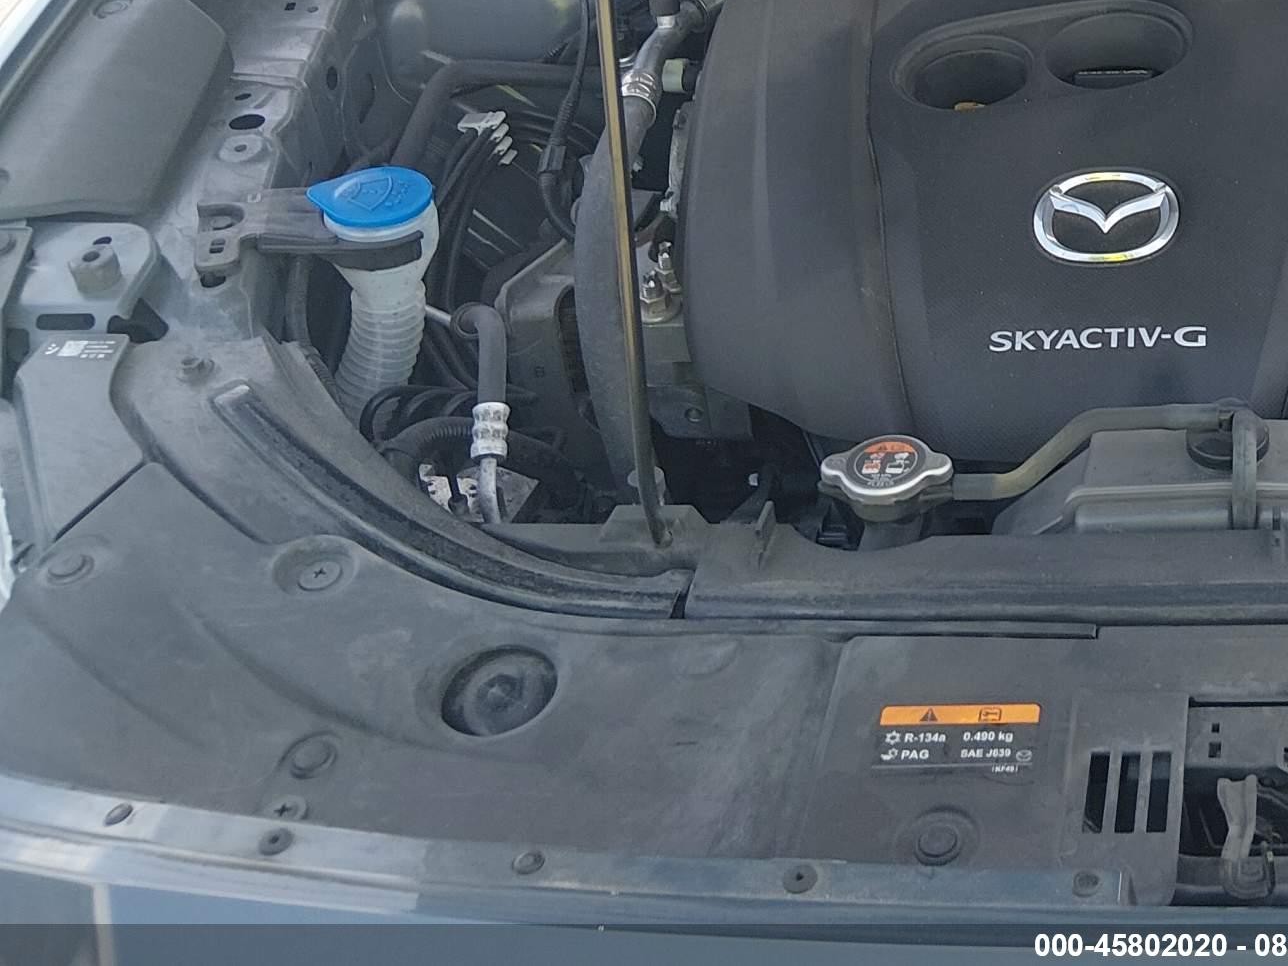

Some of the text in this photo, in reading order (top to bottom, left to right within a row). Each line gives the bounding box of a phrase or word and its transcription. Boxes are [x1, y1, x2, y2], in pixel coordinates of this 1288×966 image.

[988, 325, 1208, 352] SKYACTIV-G
[904, 731, 1014, 743] R-134a 0.490 kg
[900, 749, 930, 760] PAG
[960, 748, 984, 759] SAE
